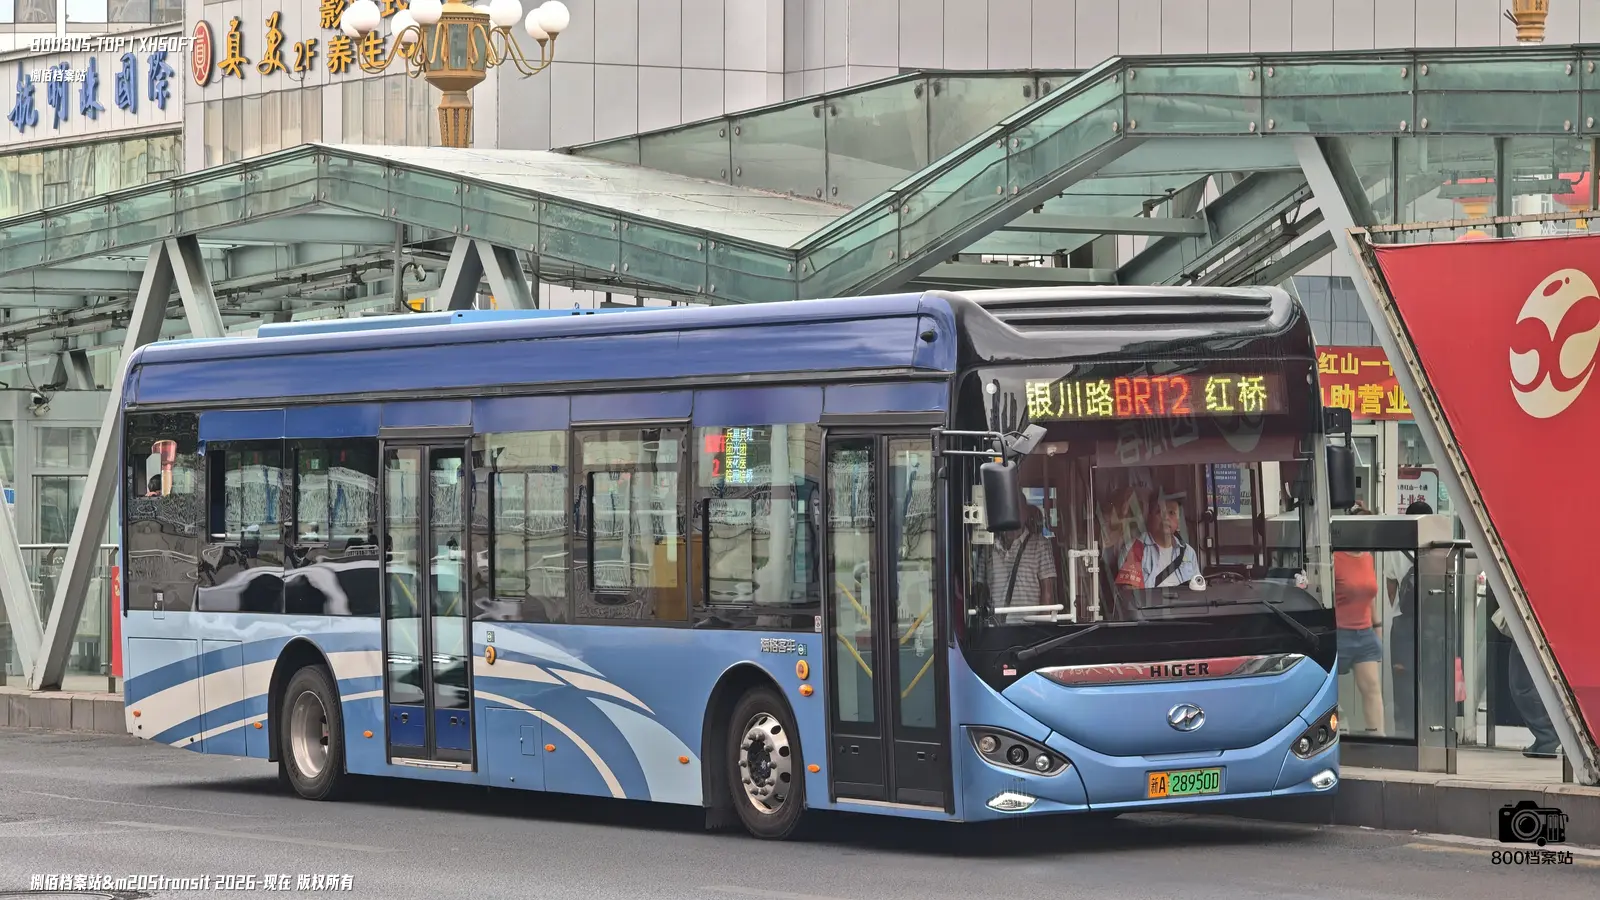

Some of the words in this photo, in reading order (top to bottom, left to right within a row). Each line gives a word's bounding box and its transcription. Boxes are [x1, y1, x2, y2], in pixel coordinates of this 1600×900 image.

[293, 38, 316, 72] 2F
[1025, 378, 1114, 419] 银川路
[1114, 374, 1192, 417] BRT2
[1204, 375, 1268, 412] 红桥
[1319, 383, 1412, 415] 助营业
[760, 637, 796, 653] 海格客车
[1150, 662, 1210, 678] HIGER
[1172, 772, 1219, 793] 28950D
